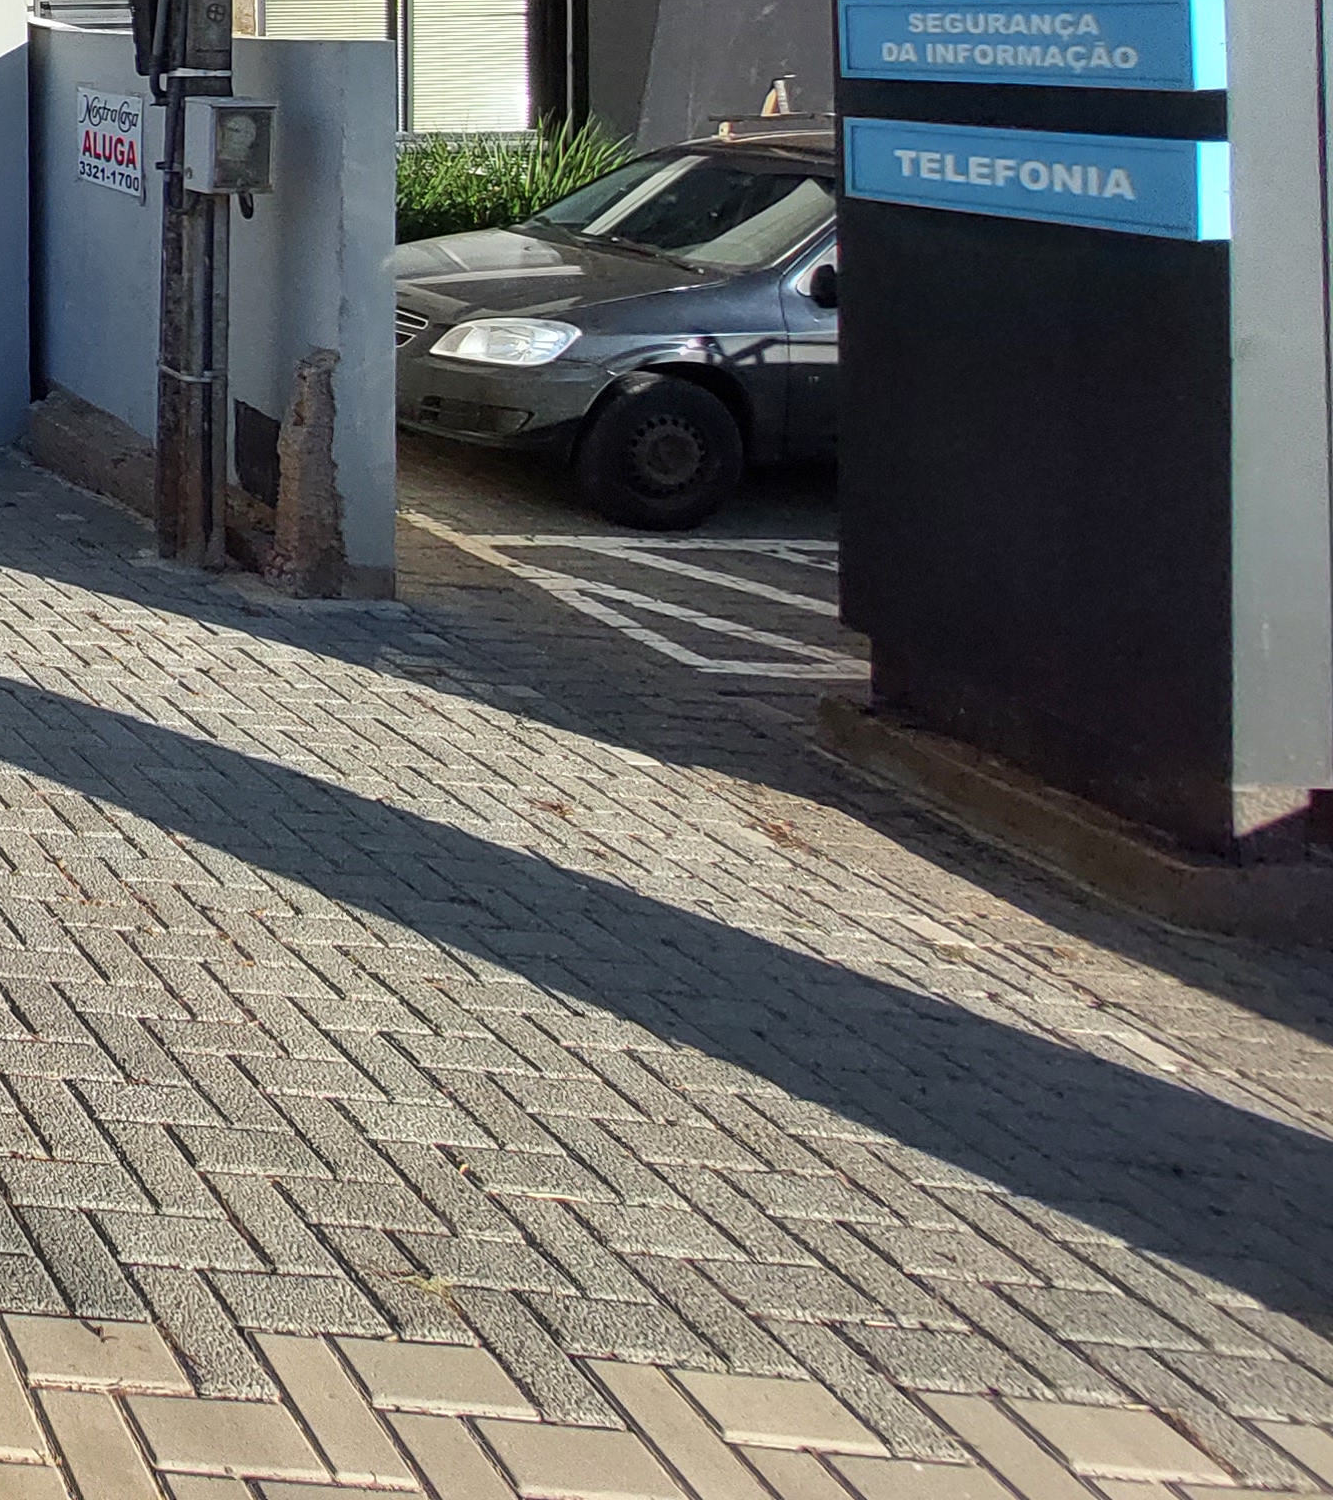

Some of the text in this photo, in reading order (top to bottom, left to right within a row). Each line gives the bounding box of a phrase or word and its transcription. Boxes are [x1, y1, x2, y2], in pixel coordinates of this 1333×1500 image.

[907, 12, 1100, 43] SEGURANÇA
[881, 40, 1140, 73] DA INFORMAÇÃO
[82, 130, 137, 171] ALUGA
[79, 160, 140, 192] 3321-1700
[893, 149, 1135, 200] TELEFONIA
